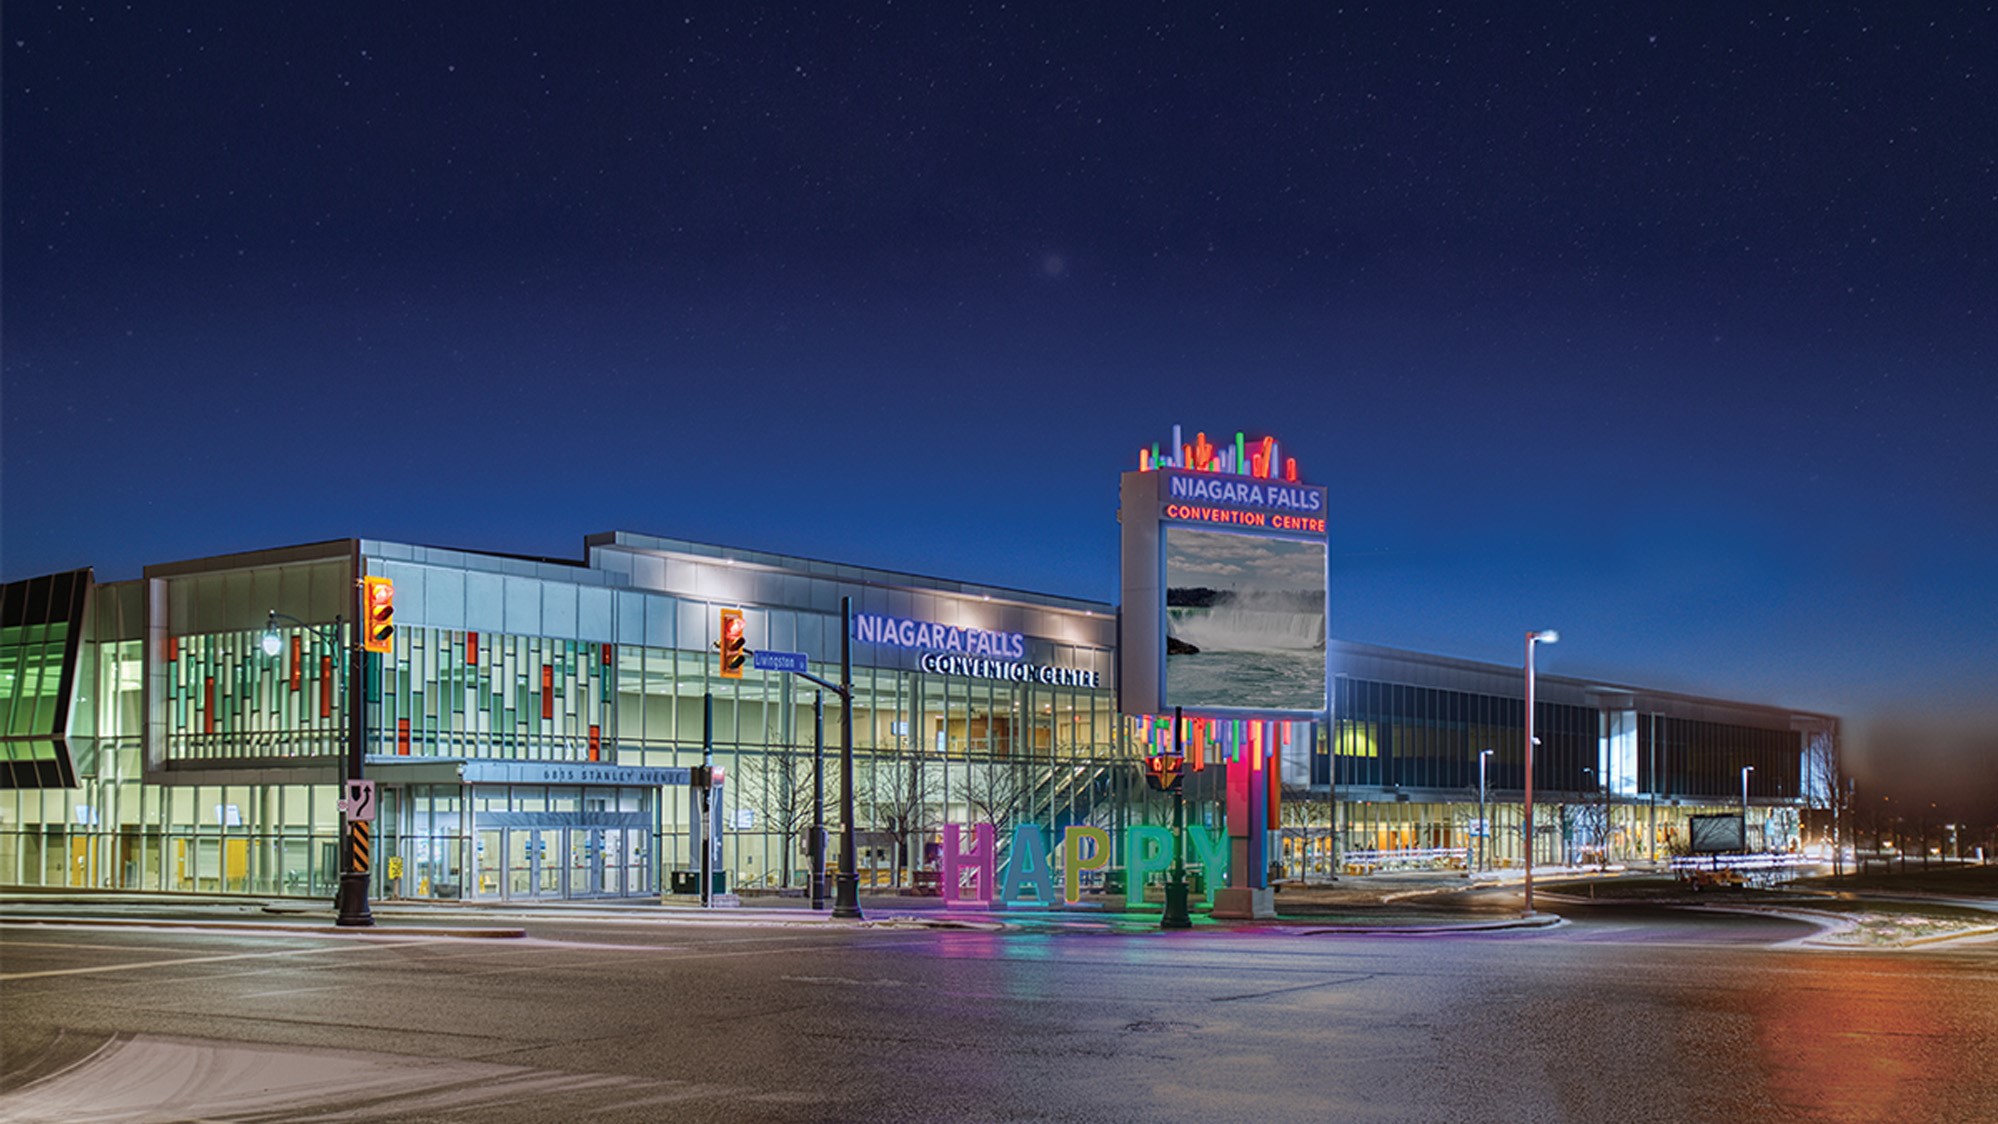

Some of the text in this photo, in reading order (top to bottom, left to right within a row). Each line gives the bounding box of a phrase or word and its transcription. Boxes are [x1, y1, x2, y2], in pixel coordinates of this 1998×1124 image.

[1171, 476, 1320, 510] NIAGARA FALLS
[1167, 504, 1326, 532] CONVENTION CENTRE
[857, 614, 1024, 658] NIAGARA FALLS
[755, 653, 795, 670] Livingston
[922, 653, 1100, 688] CONVENTION CENTRE
[544, 770, 682, 783] 6815 STANLEY AVENUE
[943, 823, 1231, 907] HAPPY
